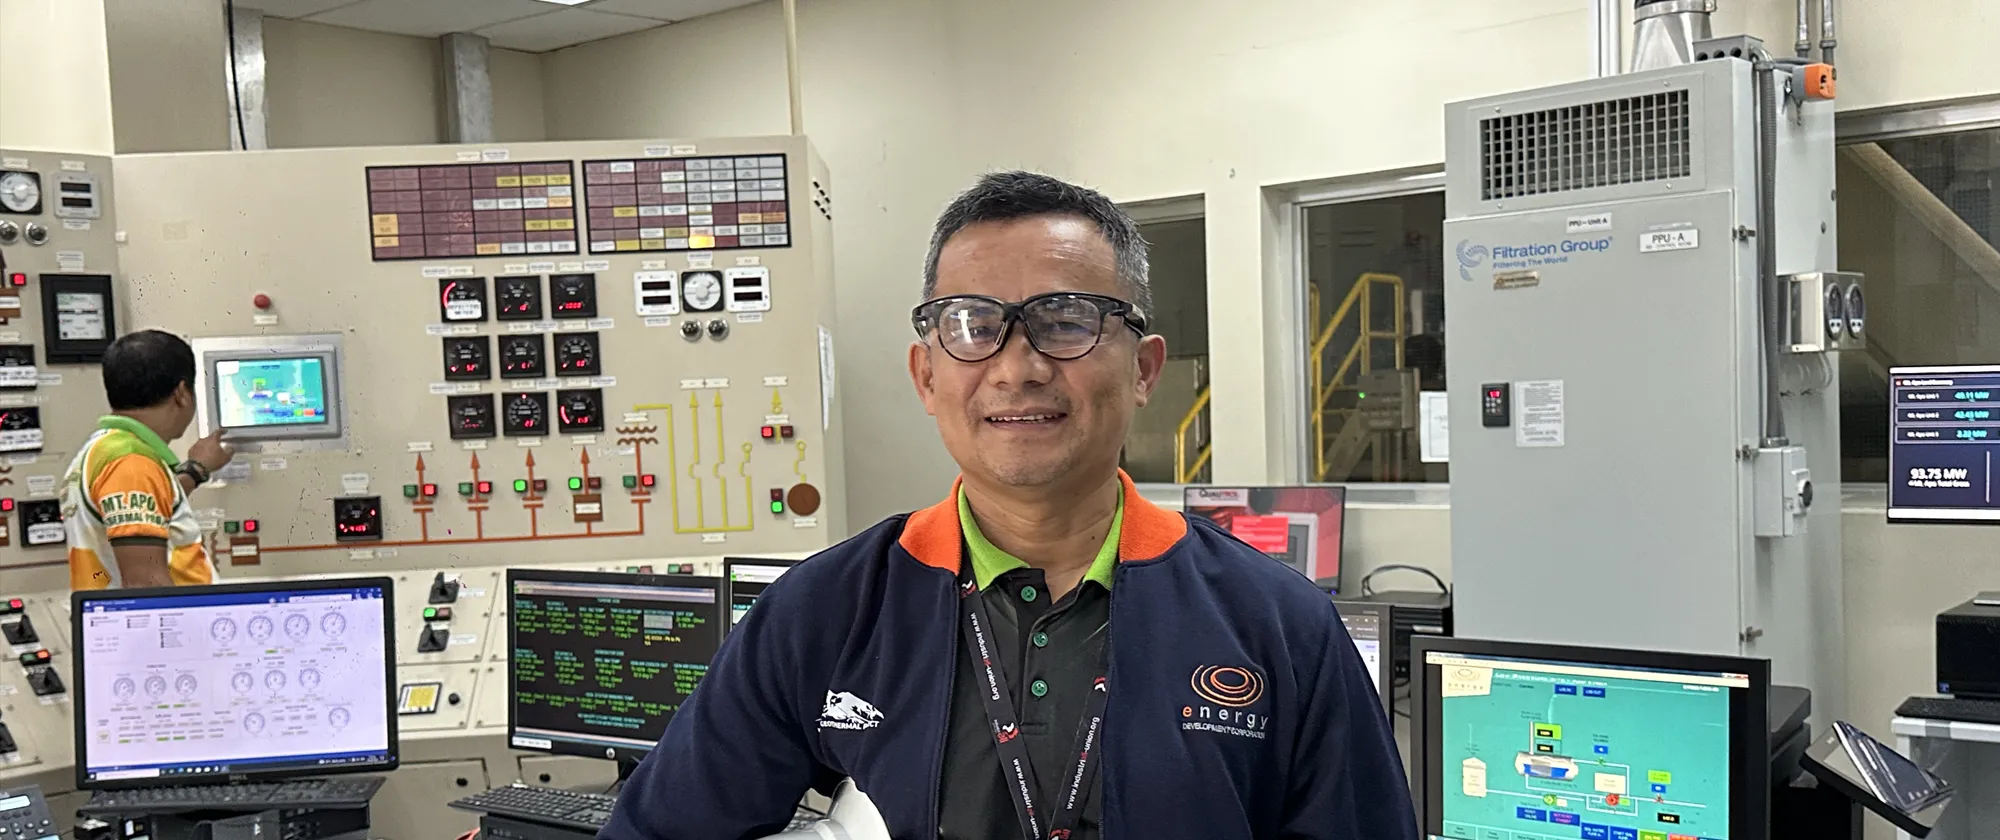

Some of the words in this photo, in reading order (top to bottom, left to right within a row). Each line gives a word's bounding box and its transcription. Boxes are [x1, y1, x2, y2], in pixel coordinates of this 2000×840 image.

[1652, 233, 1671, 244] PPU
[1677, 232, 1685, 241] A
[1492, 241, 1557, 260] Filtration
[1492, 260, 1527, 269] Filtering
[1527, 258, 1543, 267] The
[1543, 256, 1568, 265] World
[1910, 468, 1942, 479] 93.75
[1943, 468, 1967, 479] MW
[101, 494, 127, 513] MT.
[130, 493, 156, 511] APO
[1182, 705, 1269, 730] energy
